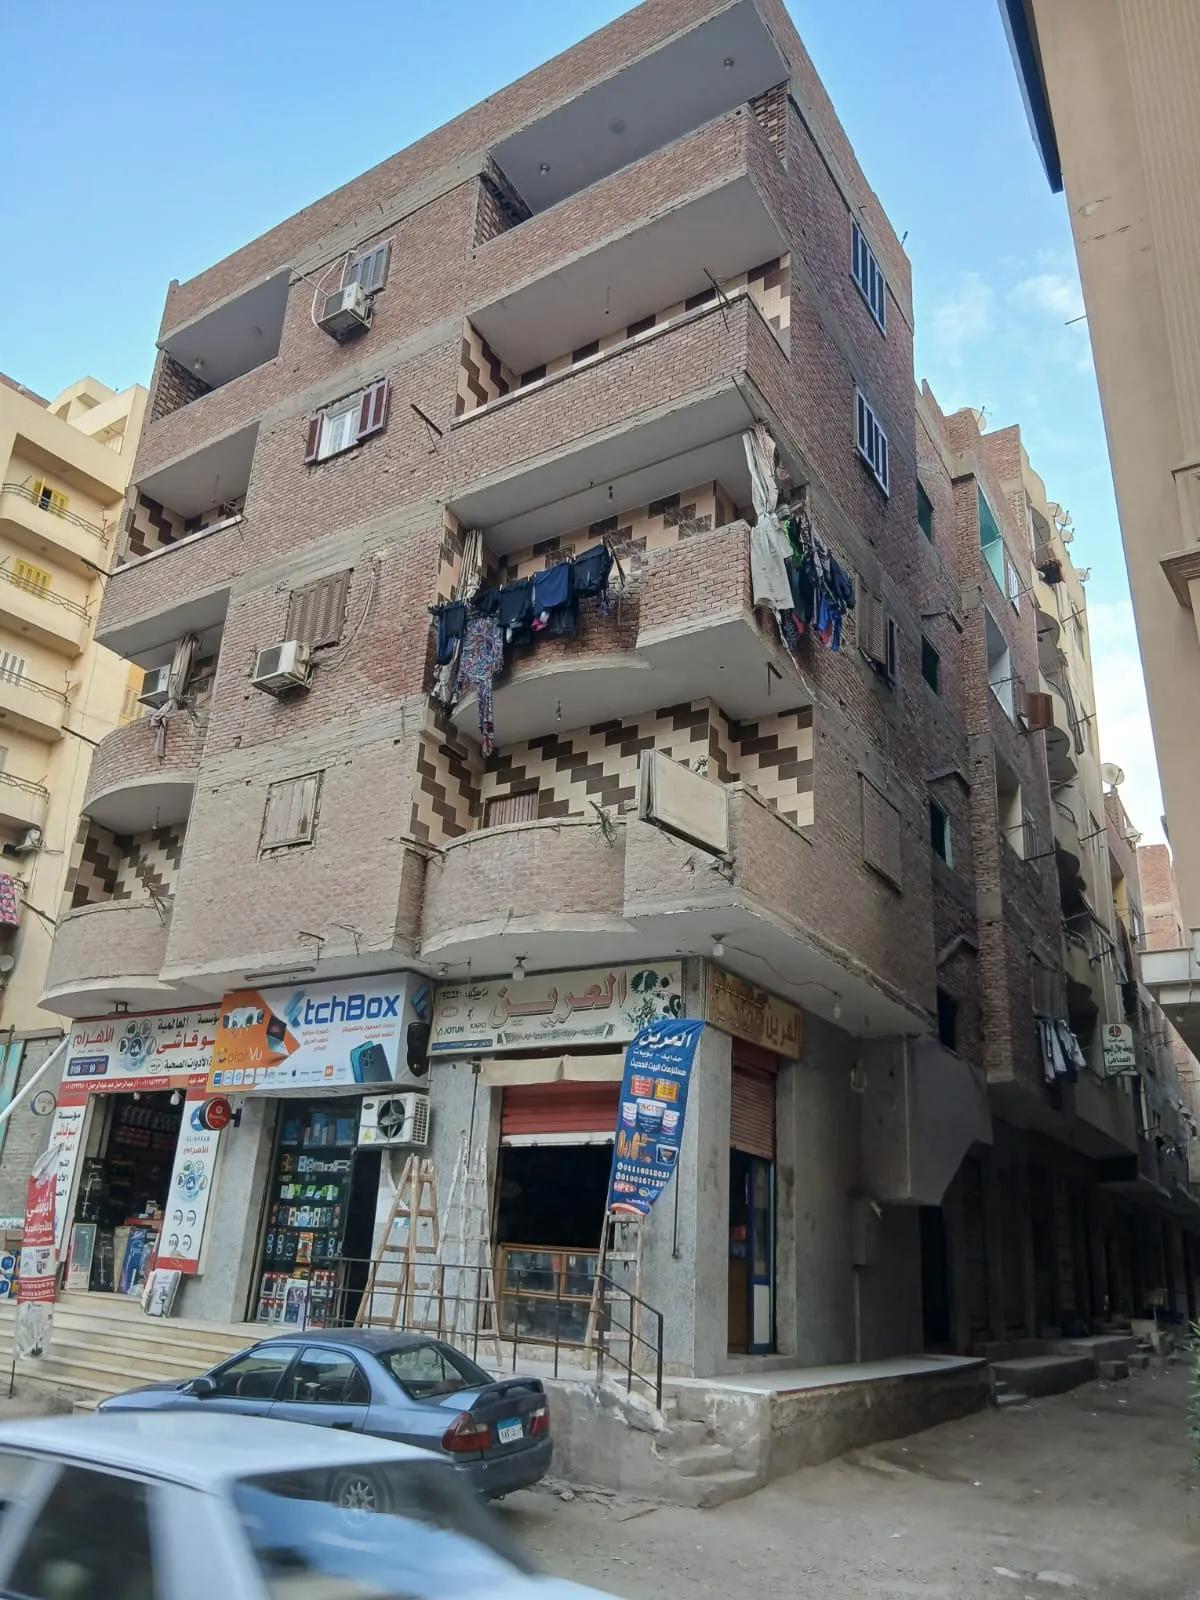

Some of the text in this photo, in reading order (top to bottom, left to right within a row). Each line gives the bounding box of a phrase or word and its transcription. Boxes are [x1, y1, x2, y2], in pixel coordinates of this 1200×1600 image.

[489, 968, 628, 1029] العرين
[444, 1025, 465, 1035] JOTUN
[639, 1028, 693, 1049] العرين
